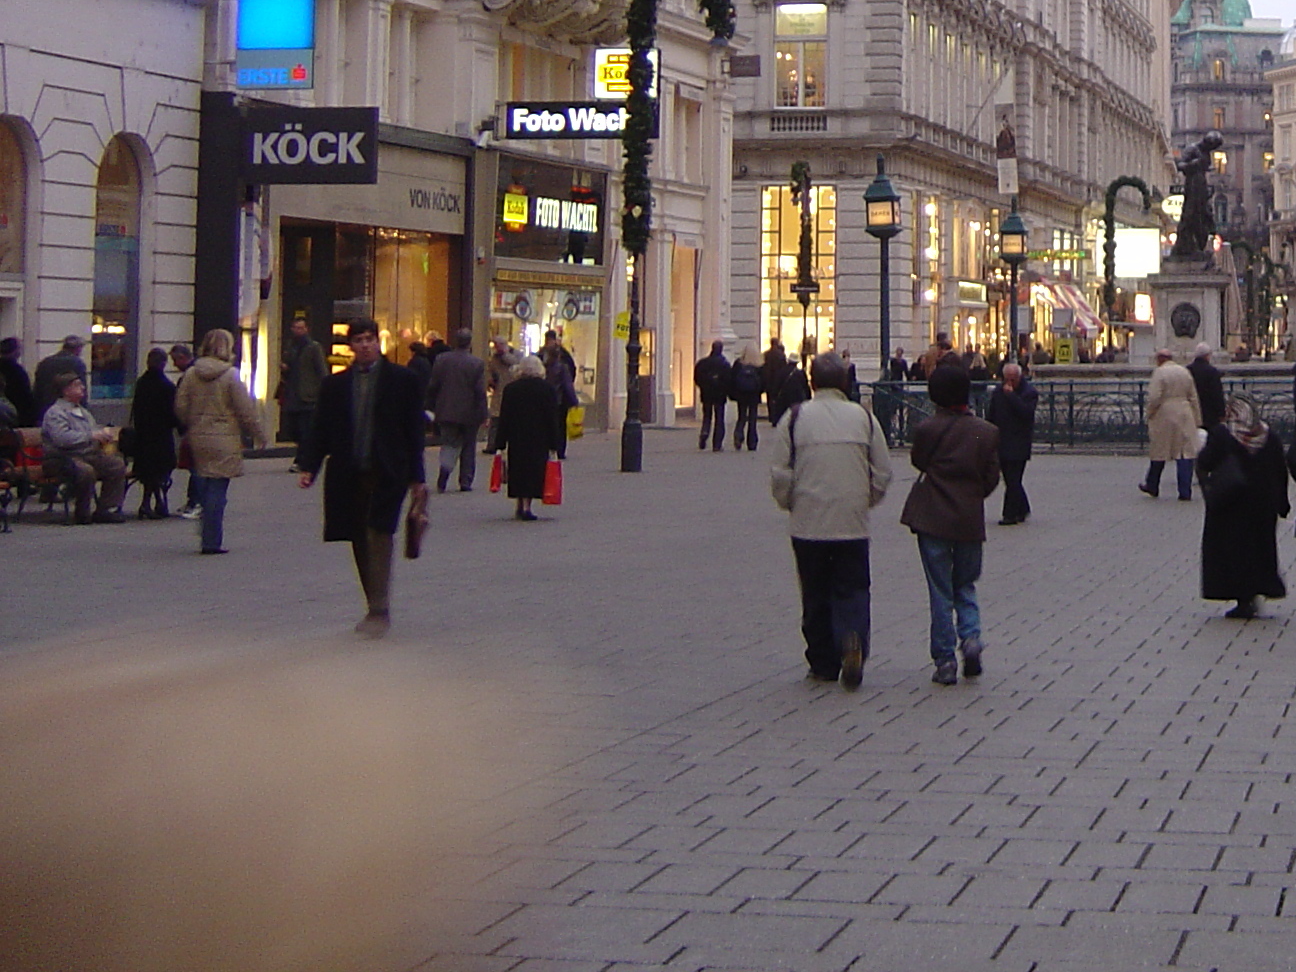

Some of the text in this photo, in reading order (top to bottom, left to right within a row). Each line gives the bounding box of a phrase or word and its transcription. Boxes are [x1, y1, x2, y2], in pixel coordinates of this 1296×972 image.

[238, 67, 288, 85] ERSTE
[513, 108, 565, 131] Foto
[253, 123, 366, 165] KÖCK
[409, 186, 462, 213] VON KÖCK
[535, 196, 598, 233] FOTO WACHTL
